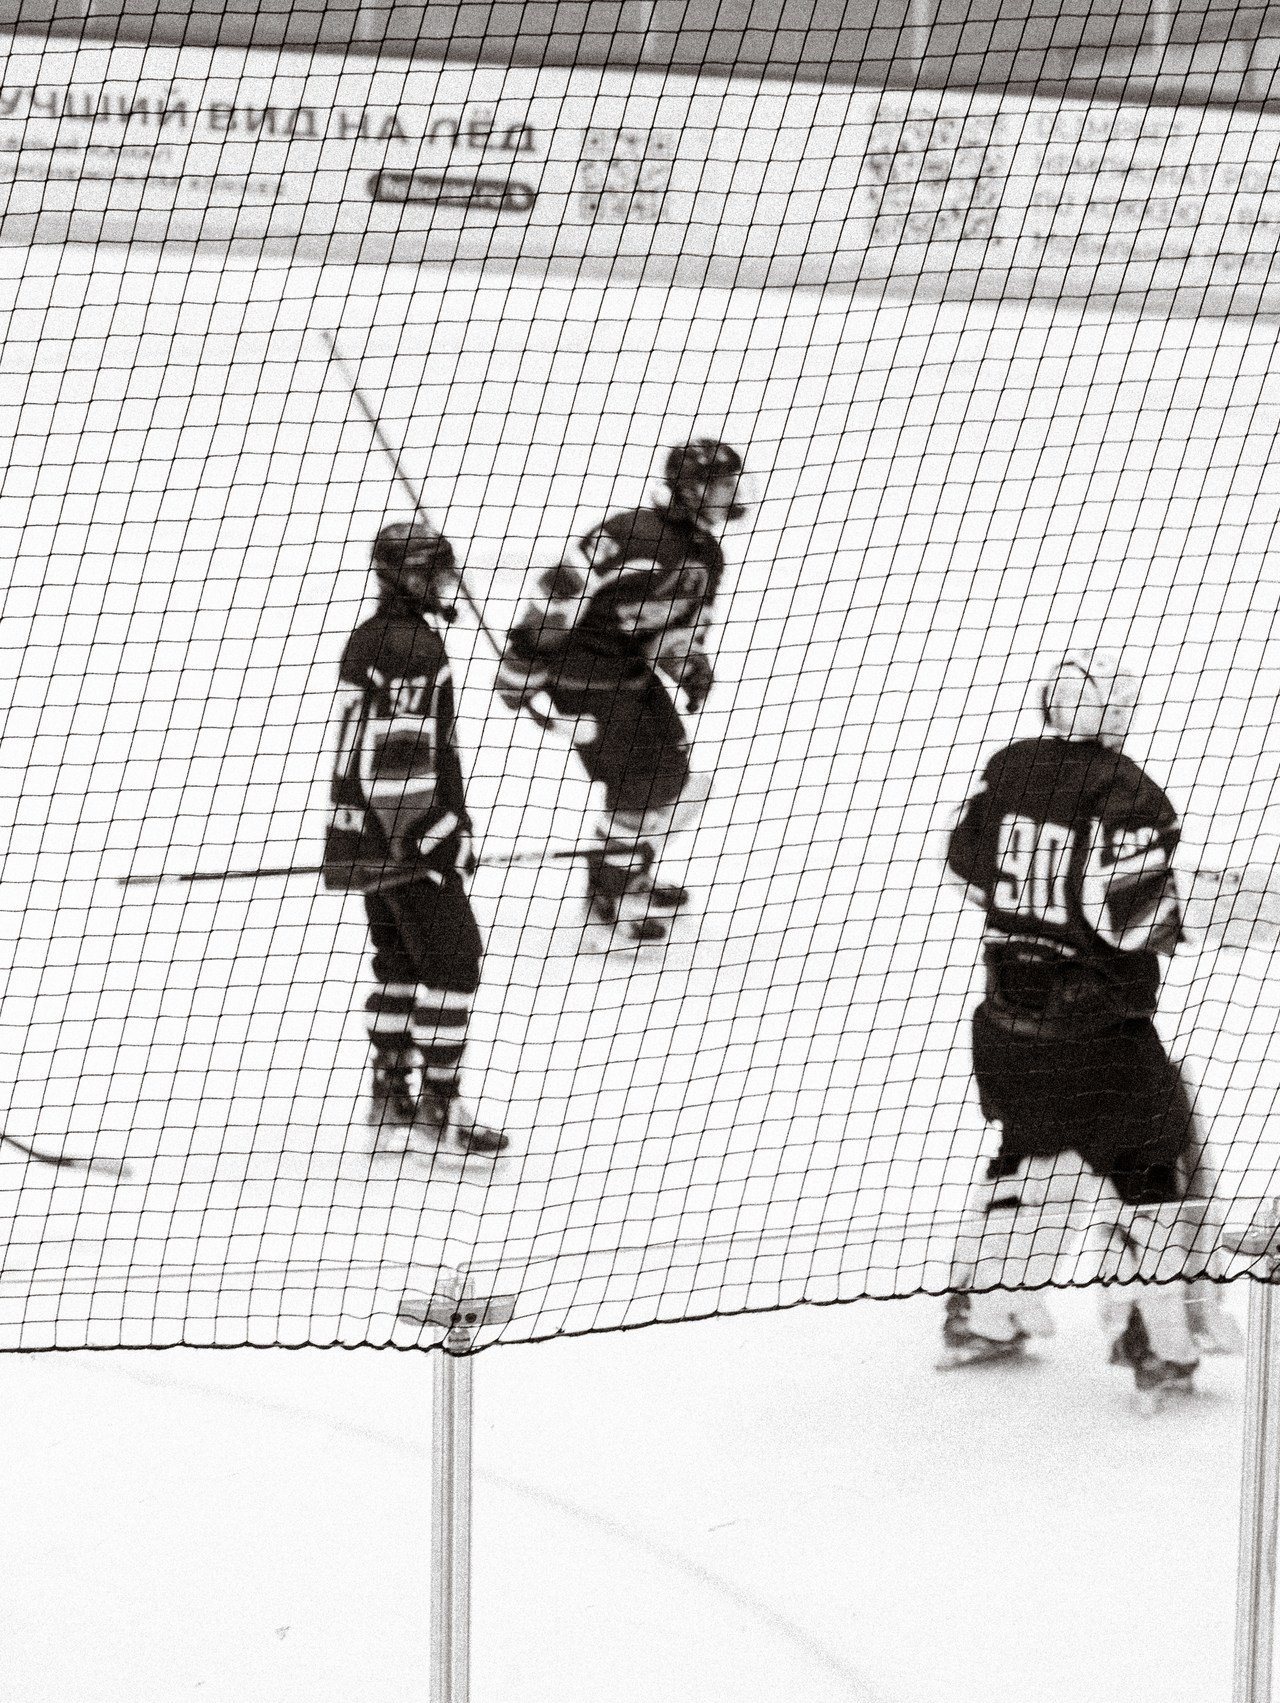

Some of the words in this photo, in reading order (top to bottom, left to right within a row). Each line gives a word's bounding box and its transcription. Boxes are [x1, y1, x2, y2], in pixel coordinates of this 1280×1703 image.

[207, 100, 319, 139] ВИД
[338, 110, 408, 146] НА
[427, 107, 536, 152] ЛЁД
[993, 813, 1076, 926] 90
